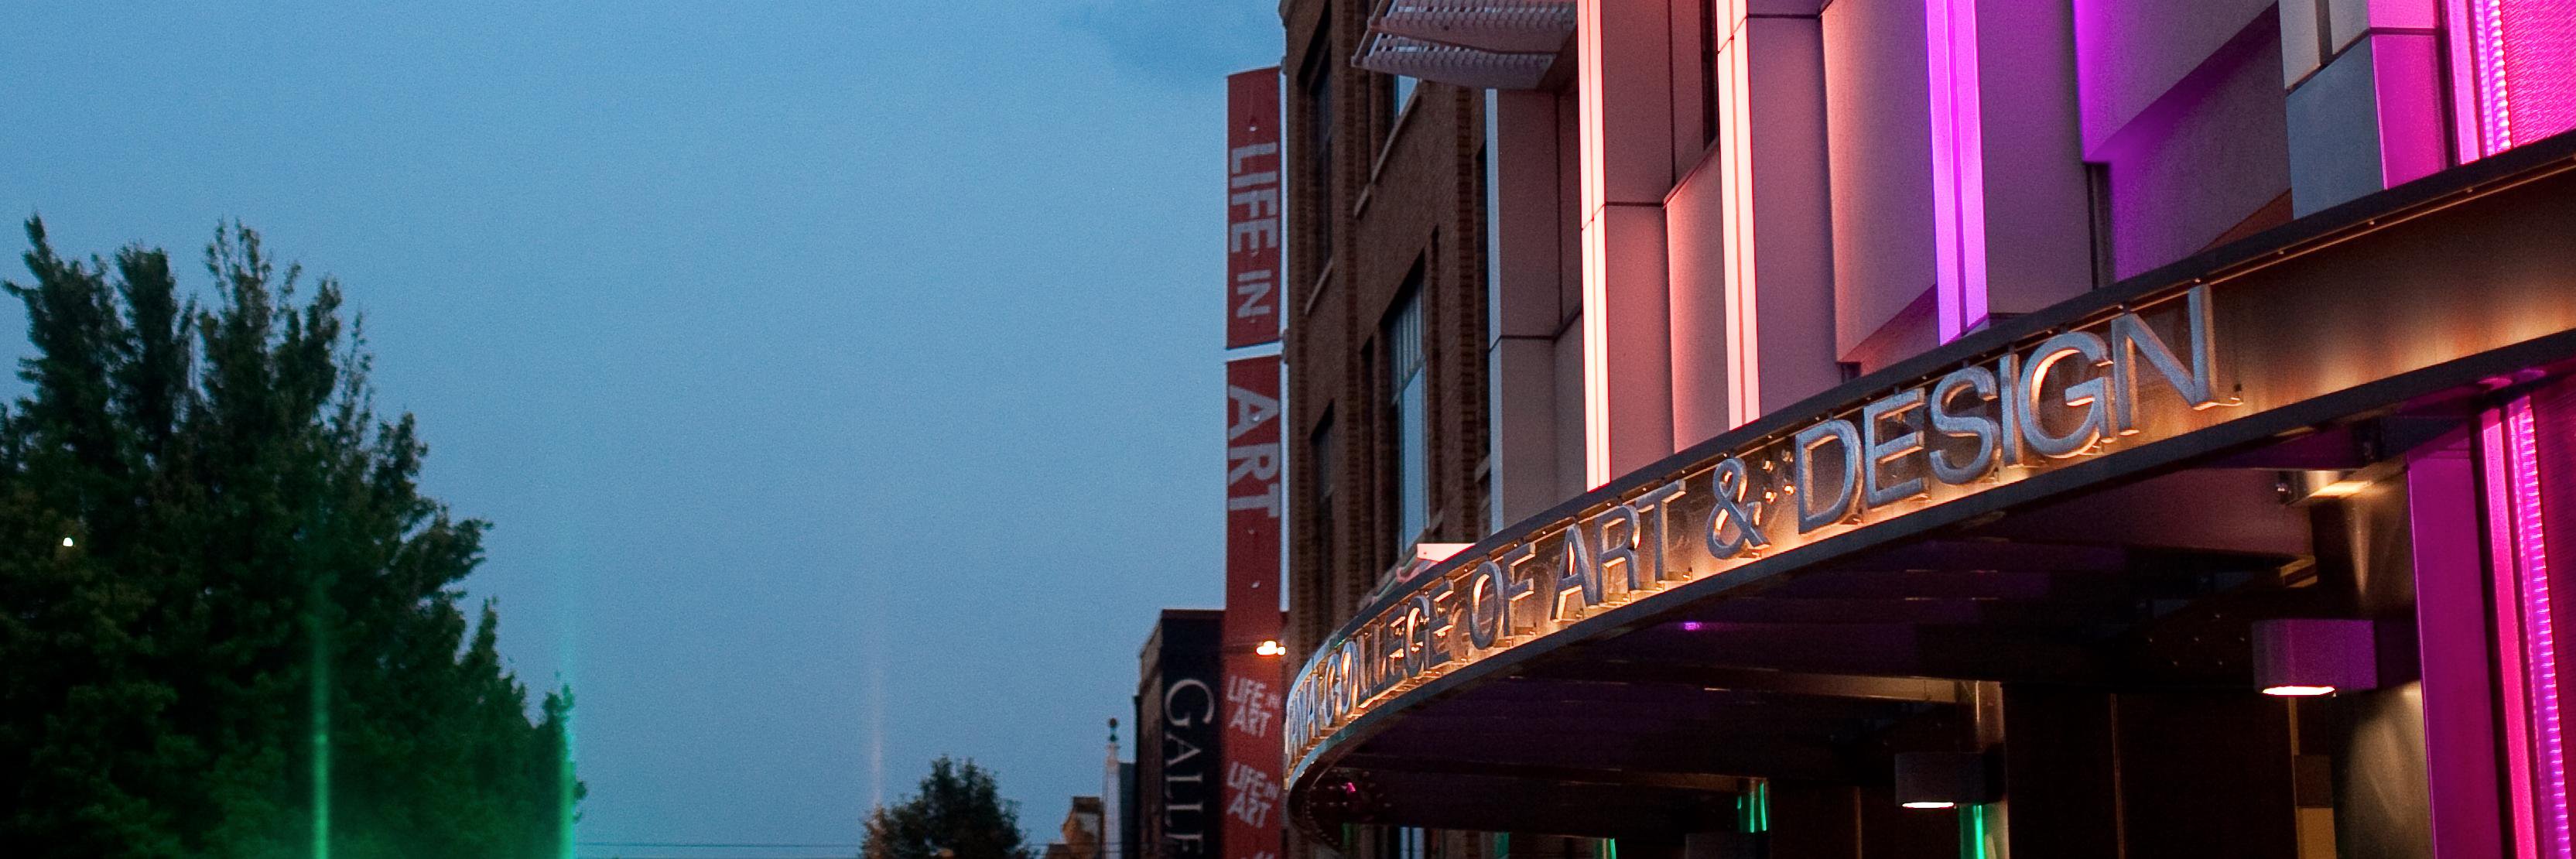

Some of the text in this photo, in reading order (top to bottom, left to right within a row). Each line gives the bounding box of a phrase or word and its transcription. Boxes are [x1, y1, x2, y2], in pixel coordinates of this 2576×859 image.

[1228, 142, 1280, 518] LIFE IN ART
[1324, 579, 1455, 727] COLLEGE
[1470, 541, 1536, 650] OF
[1550, 478, 1686, 621] ART
[1706, 457, 1772, 560] &
[1795, 283, 2218, 536] DESIGN
[1226, 675, 1267, 708] LIFE
[1228, 704, 1273, 738] ART
[1226, 761, 1268, 797] LIFE
[1226, 791, 1273, 830] ART
